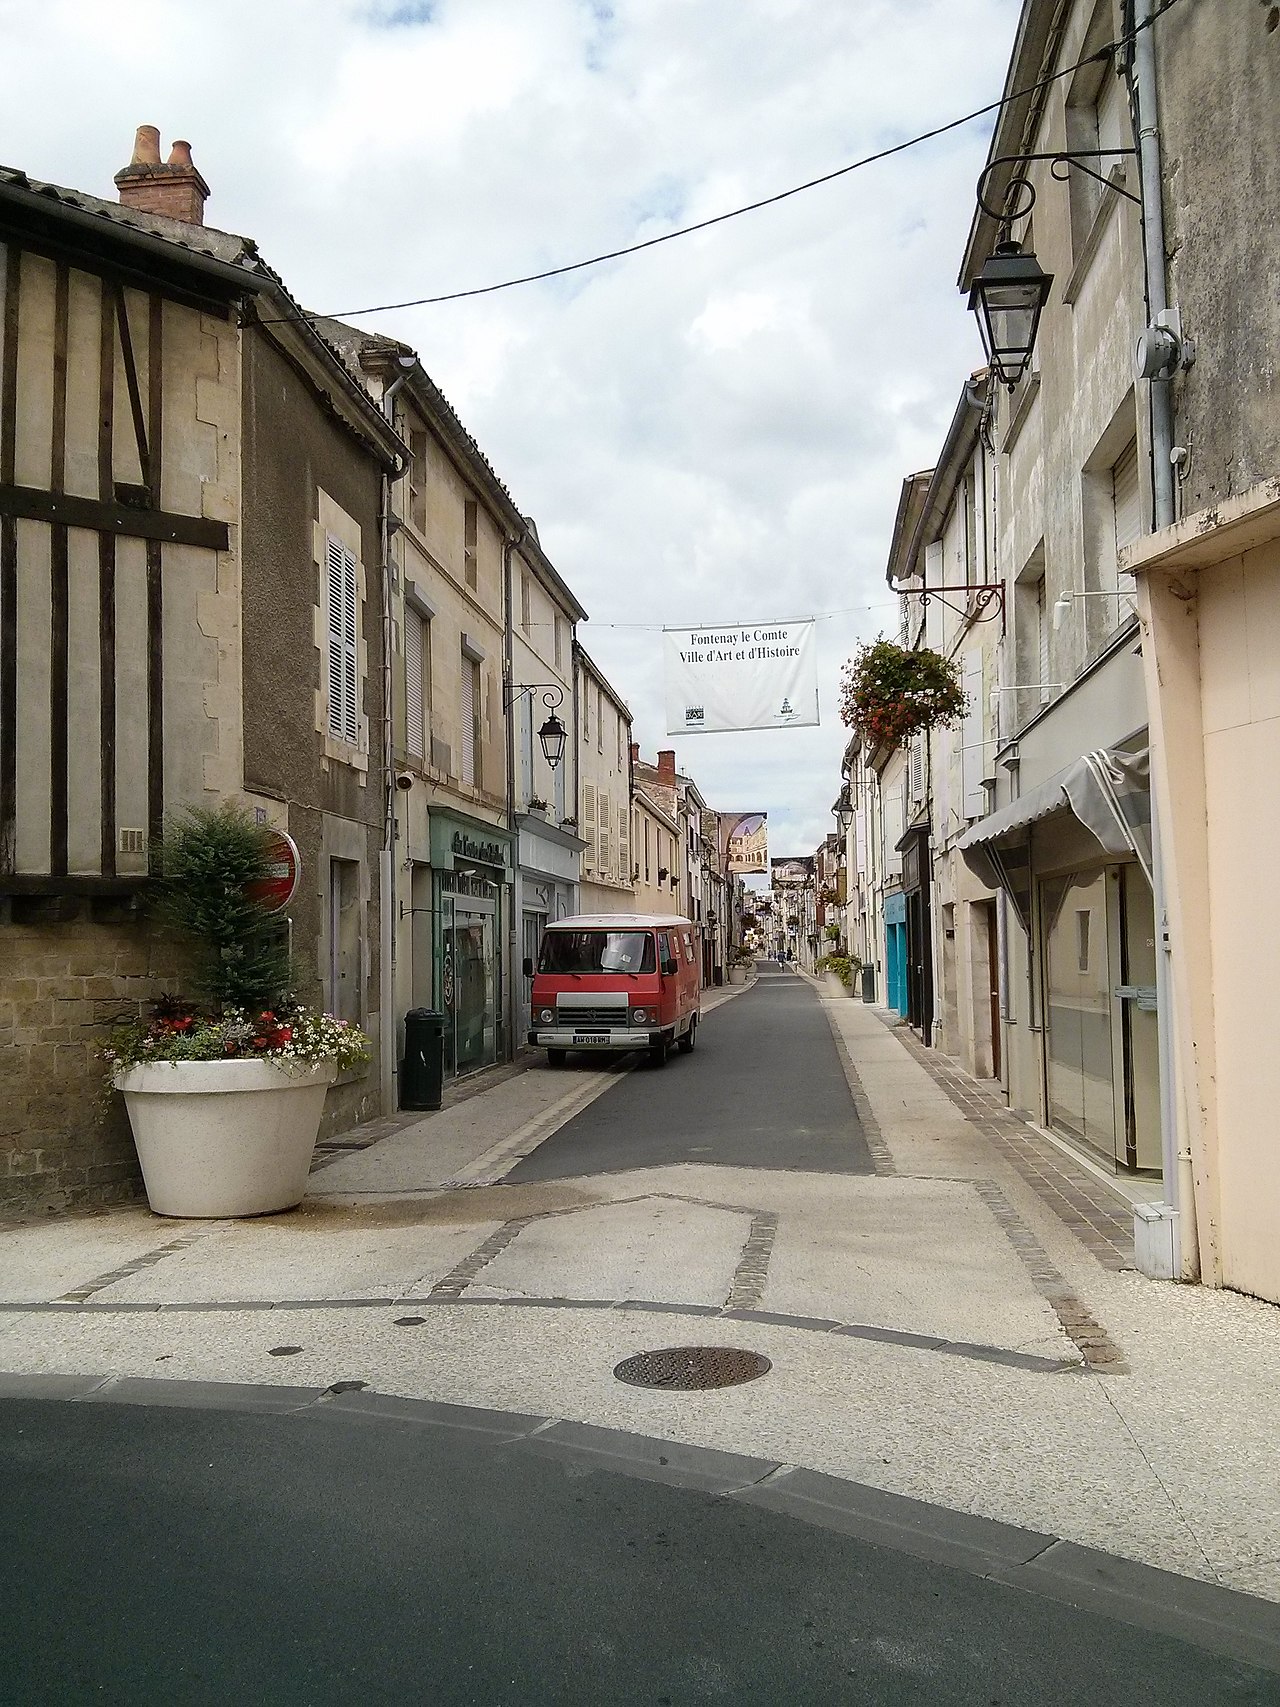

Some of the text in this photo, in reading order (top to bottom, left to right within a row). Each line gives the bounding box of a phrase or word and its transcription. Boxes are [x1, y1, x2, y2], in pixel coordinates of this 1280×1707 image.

[691, 629, 788, 646] Fontenay le Comte
[680, 645, 800, 663] Ville d'Art et d'Histoire
